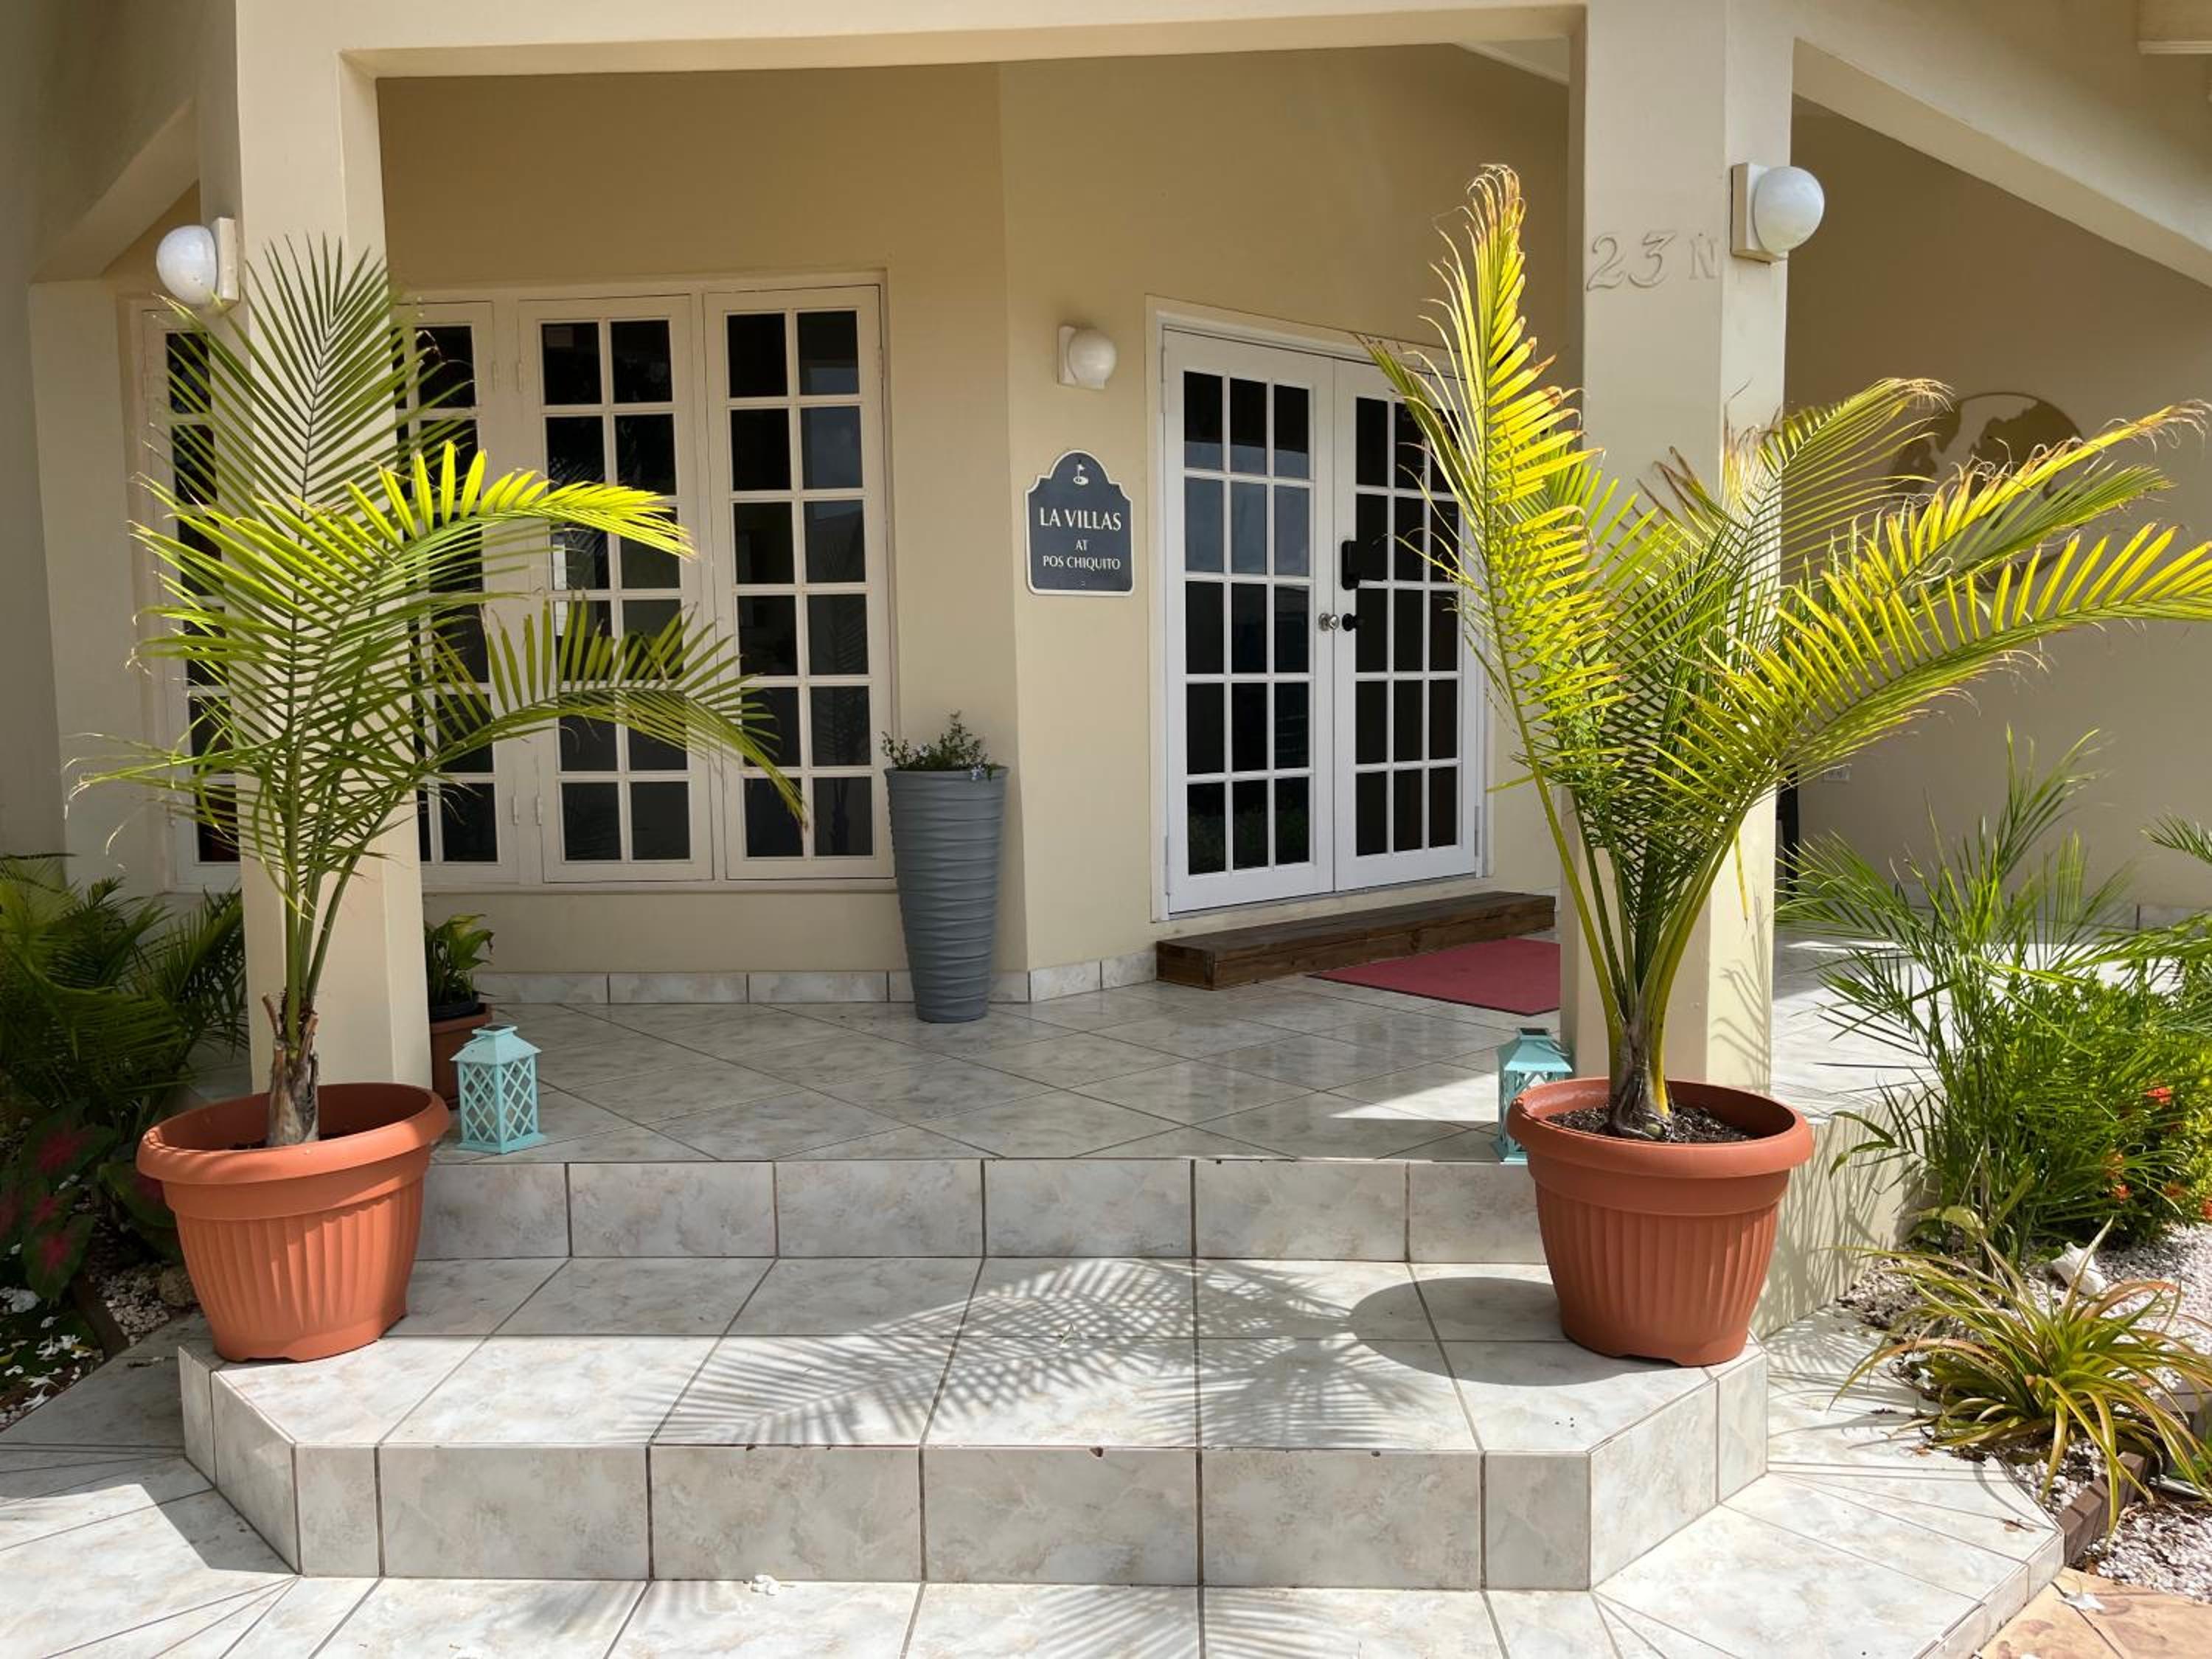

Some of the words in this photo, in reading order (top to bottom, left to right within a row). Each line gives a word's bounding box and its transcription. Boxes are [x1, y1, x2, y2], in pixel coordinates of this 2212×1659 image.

[1586, 231, 1677, 292] 23
[1040, 507, 1062, 527] LA
[1065, 509, 1121, 531] VILLAS
[1076, 540, 1089, 551] AT
[1043, 555, 1064, 568] POS
[1067, 557, 1121, 571] CHIQUITO
